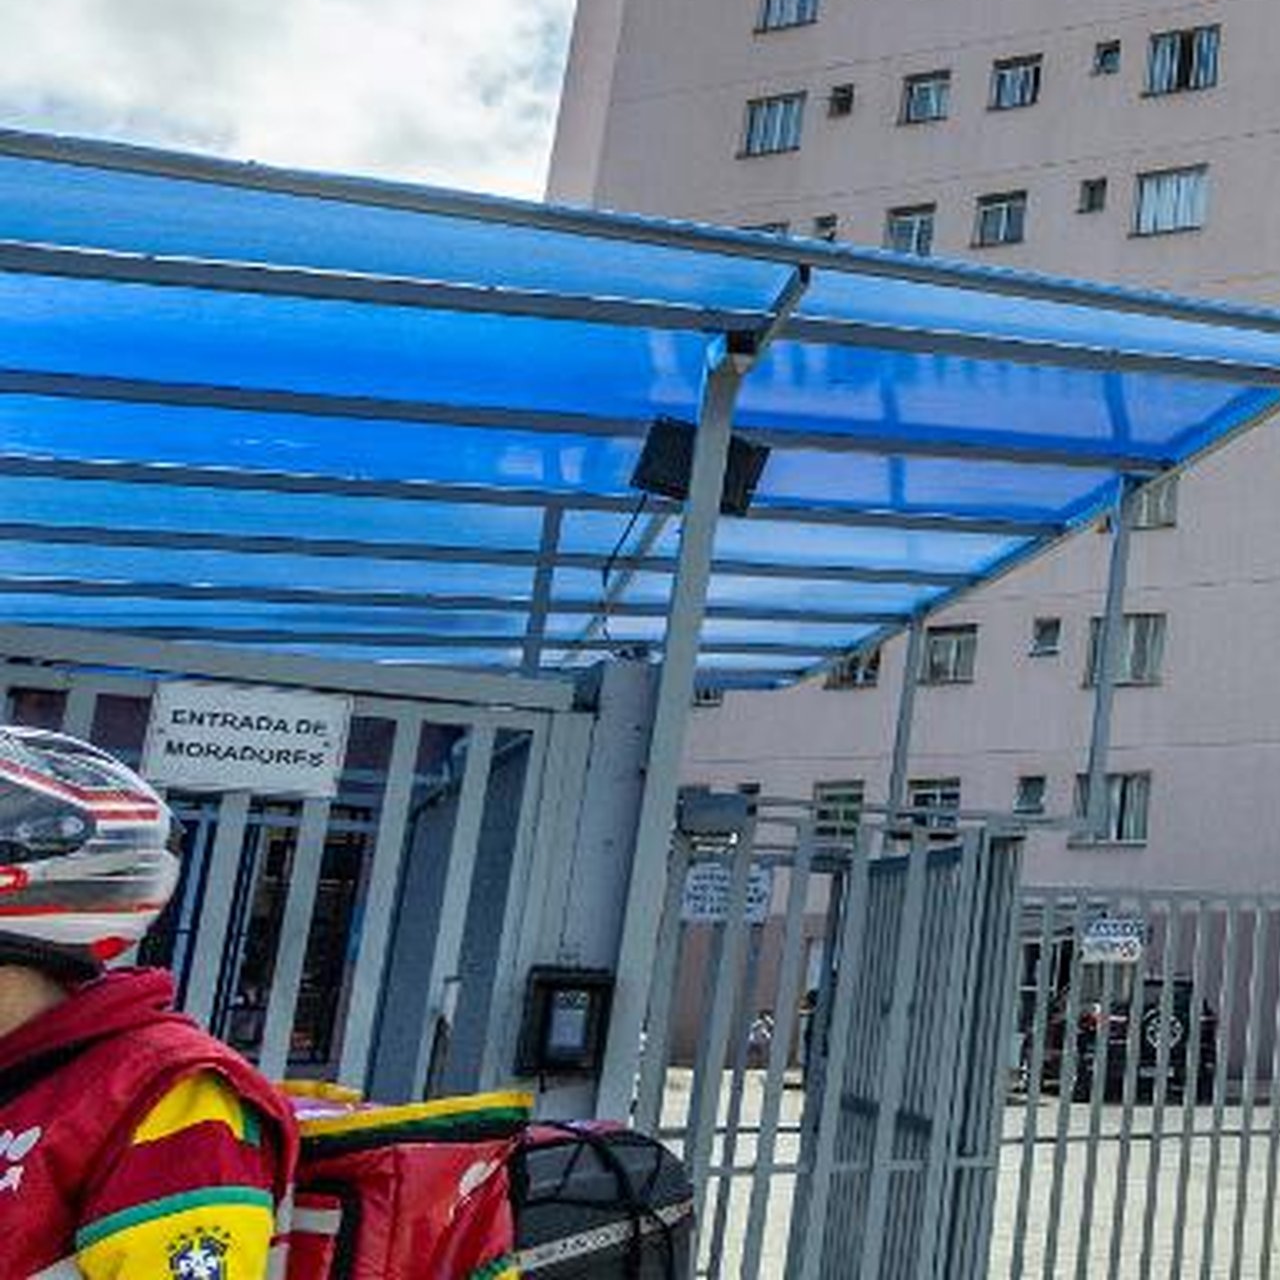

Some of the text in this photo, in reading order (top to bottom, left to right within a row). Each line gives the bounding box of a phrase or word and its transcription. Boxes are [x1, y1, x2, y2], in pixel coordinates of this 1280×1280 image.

[171, 709, 328, 737] ENTRADA DE
[164, 739, 325, 768] MORADORES
